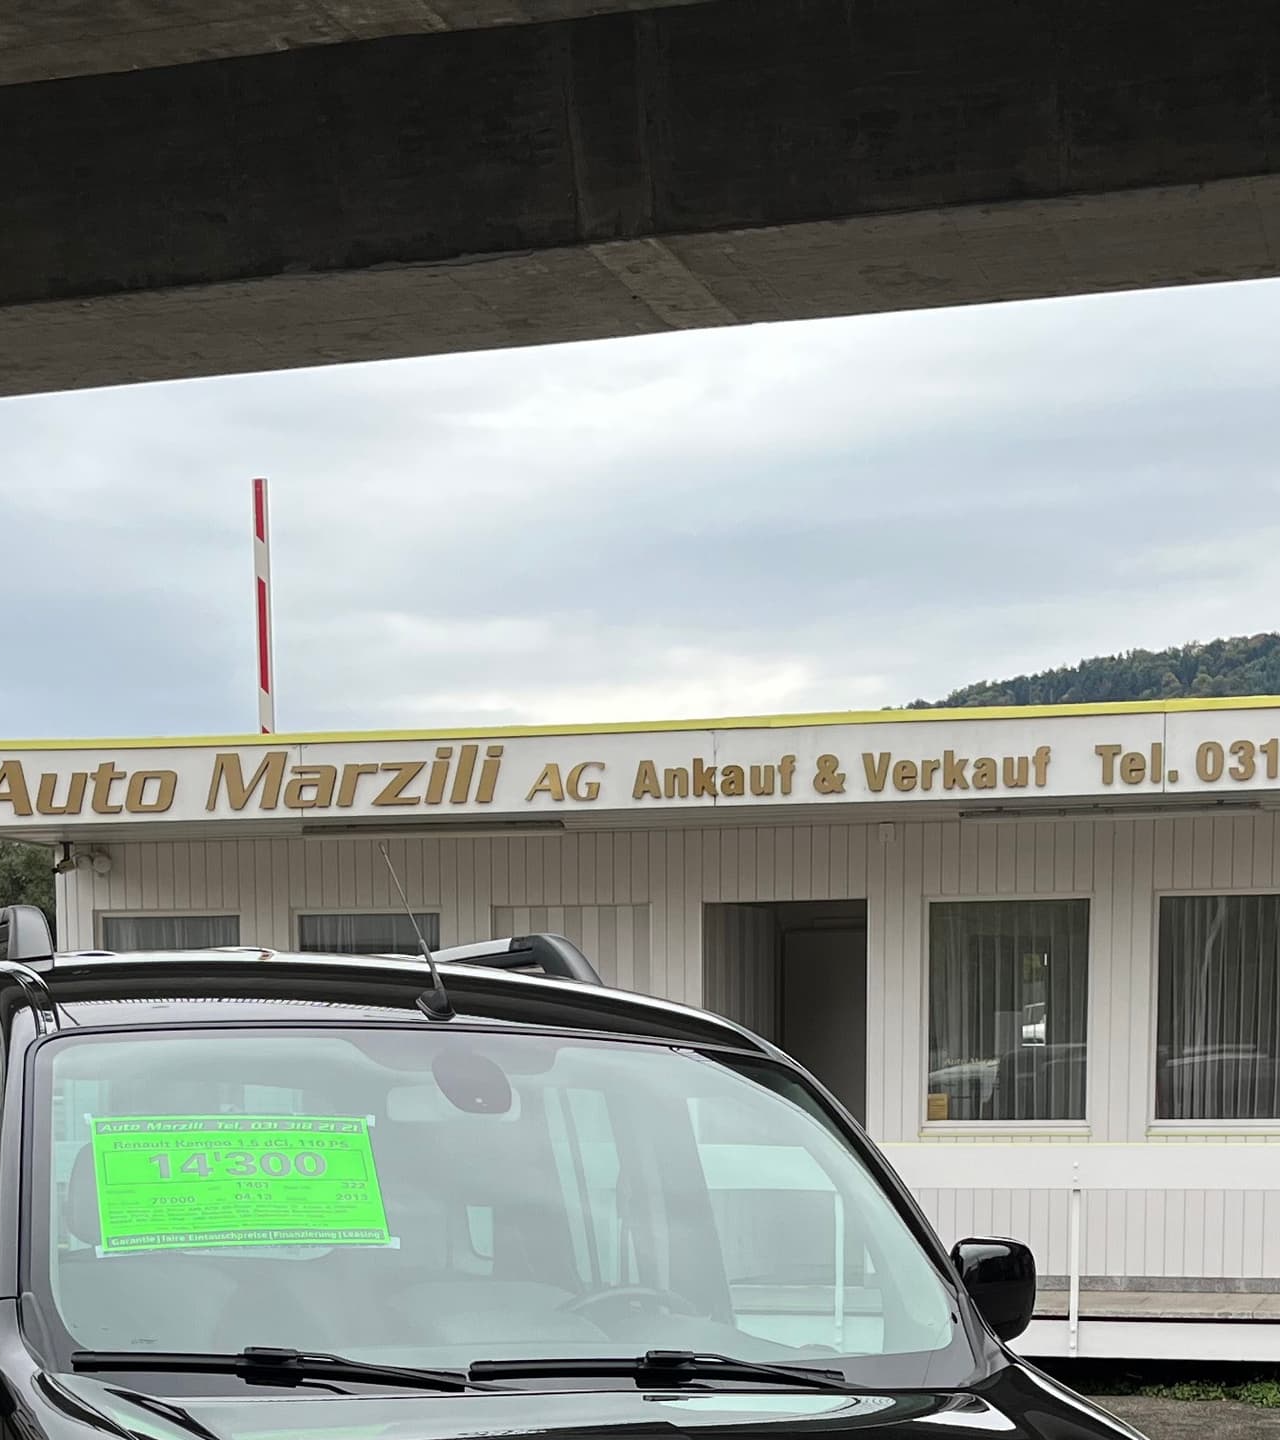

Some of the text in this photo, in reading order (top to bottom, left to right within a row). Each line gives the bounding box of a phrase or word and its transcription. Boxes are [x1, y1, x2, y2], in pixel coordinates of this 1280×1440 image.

[206, 745, 504, 811] Marzili
[525, 762, 606, 801] AG
[632, 755, 796, 801] Ankauf
[813, 753, 846, 794] &
[862, 746, 1052, 792] Verkauf
[1095, 743, 1179, 785] Tel.
[1196, 737, 1280, 782] 031
[99, 1123, 140, 1132] Auto
[318, 1122, 336, 1131] 21
[341, 1123, 358, 1132] 21
[113, 1139, 170, 1150] Renault
[175, 1139, 233, 1149] Kangoo
[148, 1151, 327, 1179] 14'300
